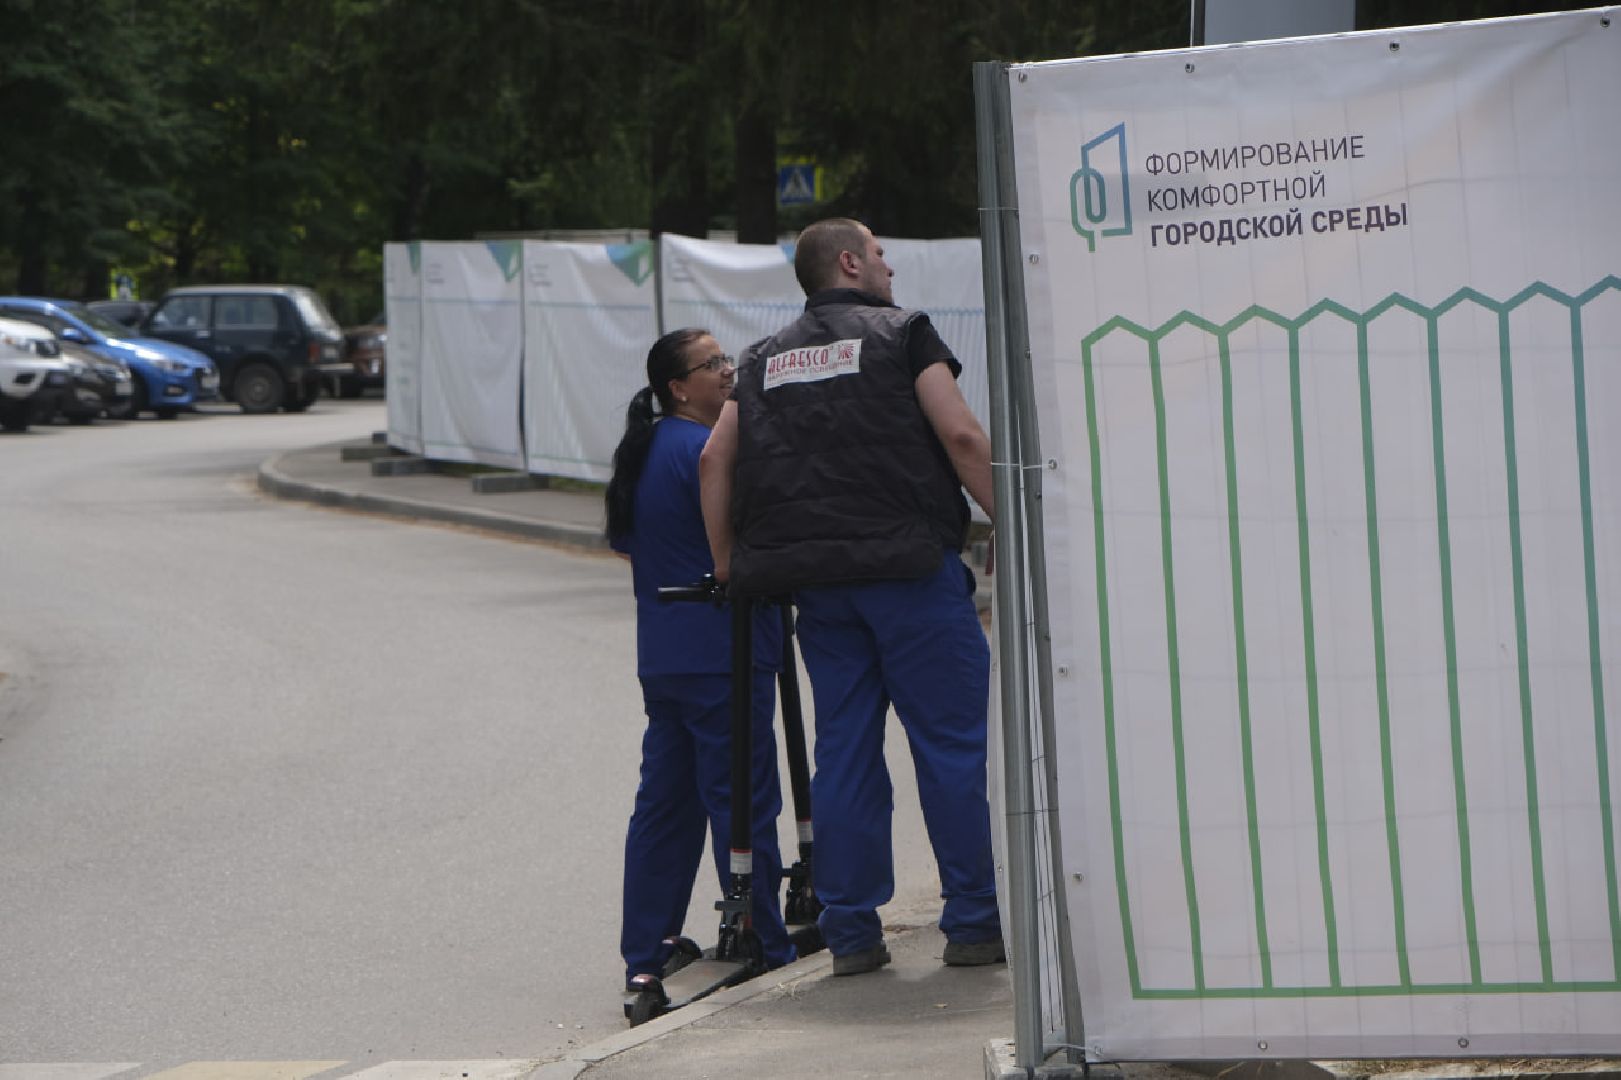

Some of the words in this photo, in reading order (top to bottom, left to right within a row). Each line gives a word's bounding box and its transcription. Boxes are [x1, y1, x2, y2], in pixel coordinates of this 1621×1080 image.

[1146, 136, 1365, 175] ФОРМИРОВАНИЕ
[1148, 171, 1326, 212] КОМФОРТНОЙ
[1151, 208, 1303, 246] ГОРОДСКОЙ
[1312, 202, 1408, 233] СРЕДЫ
